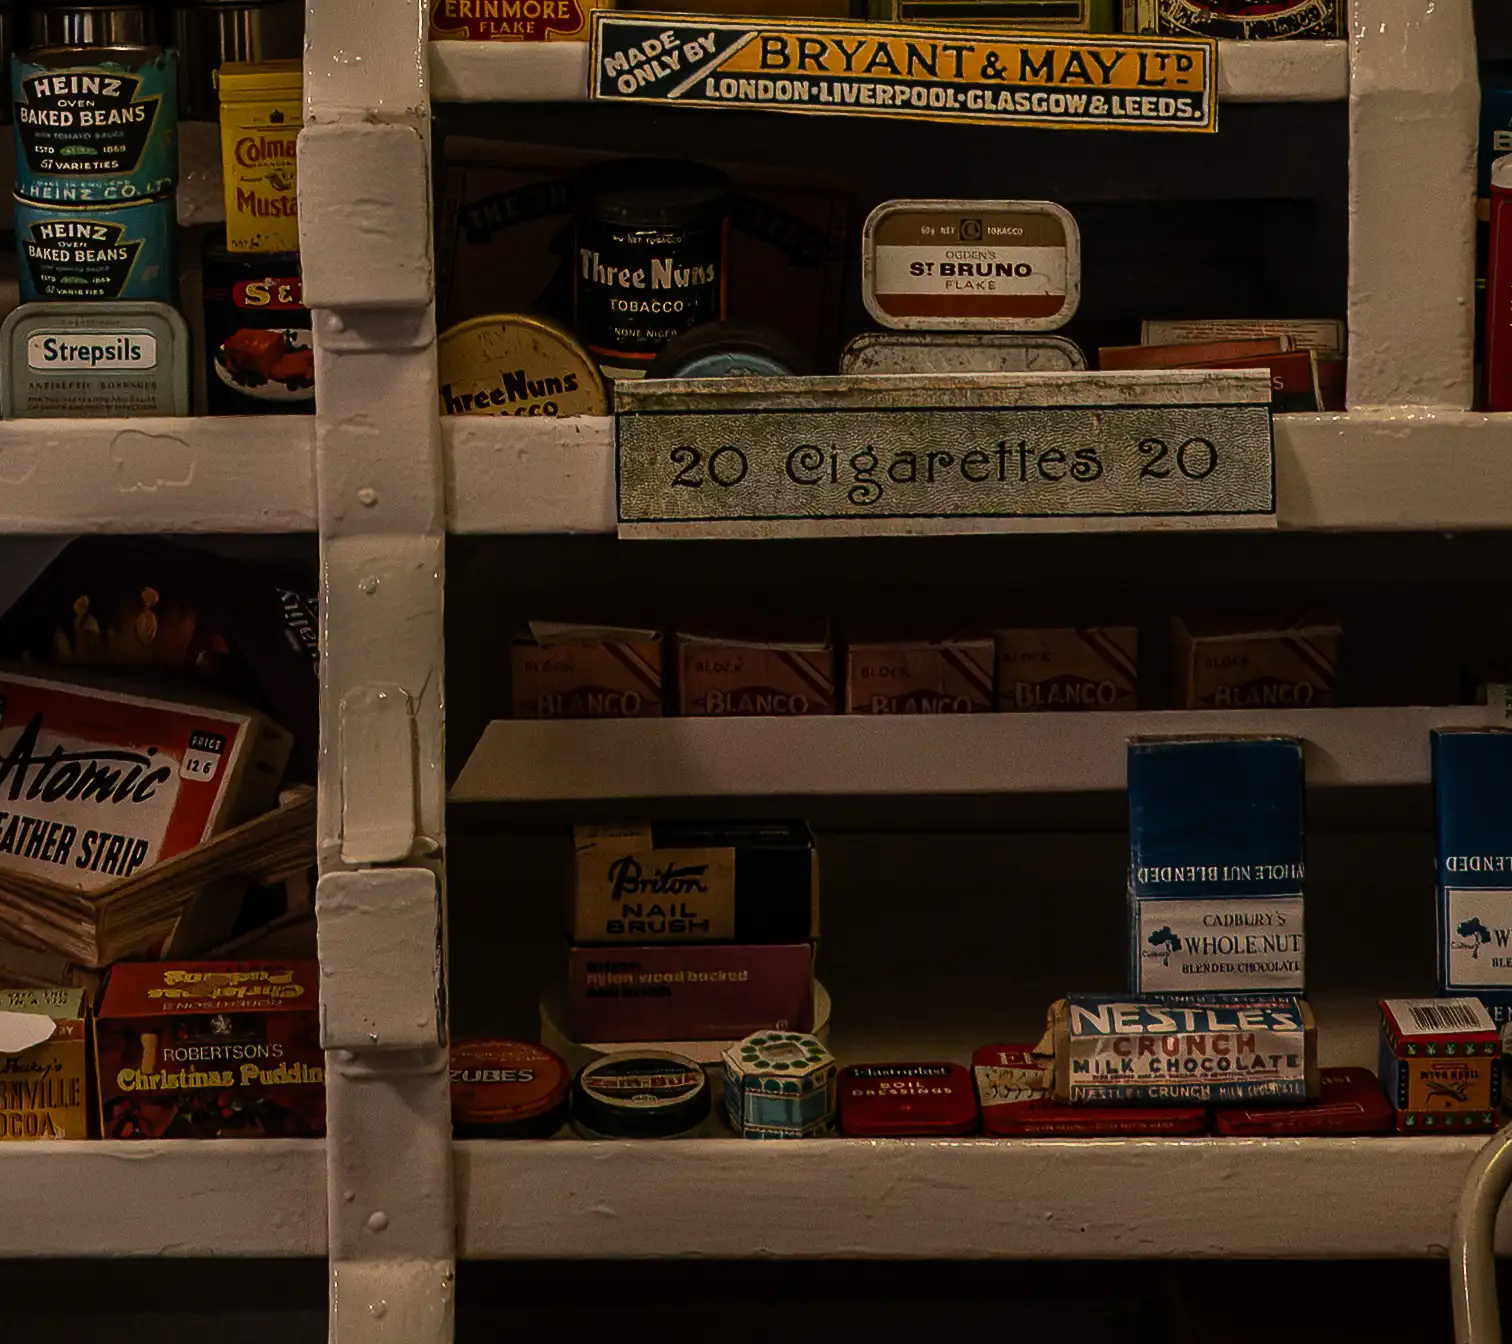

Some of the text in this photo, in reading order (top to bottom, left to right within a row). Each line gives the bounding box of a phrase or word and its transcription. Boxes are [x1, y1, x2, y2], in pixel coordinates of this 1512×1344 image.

[758, 36, 1194, 86] BRYANT & MAY LTD
[34, 76, 123, 99] HEINZ
[20, 105, 145, 127] BAKED BEANS
[43, 337, 141, 366] Strepsils
[669, 437, 1218, 506] 20 Cigarettes 20
[81, 833, 150, 878] STRIP
[621, 902, 697, 920] NAIL
[605, 917, 710, 934] BRUSH
[1111, 1034, 1257, 1058] CRUNCH
[1071, 1052, 1302, 1075] MILK CHOCOLATE
